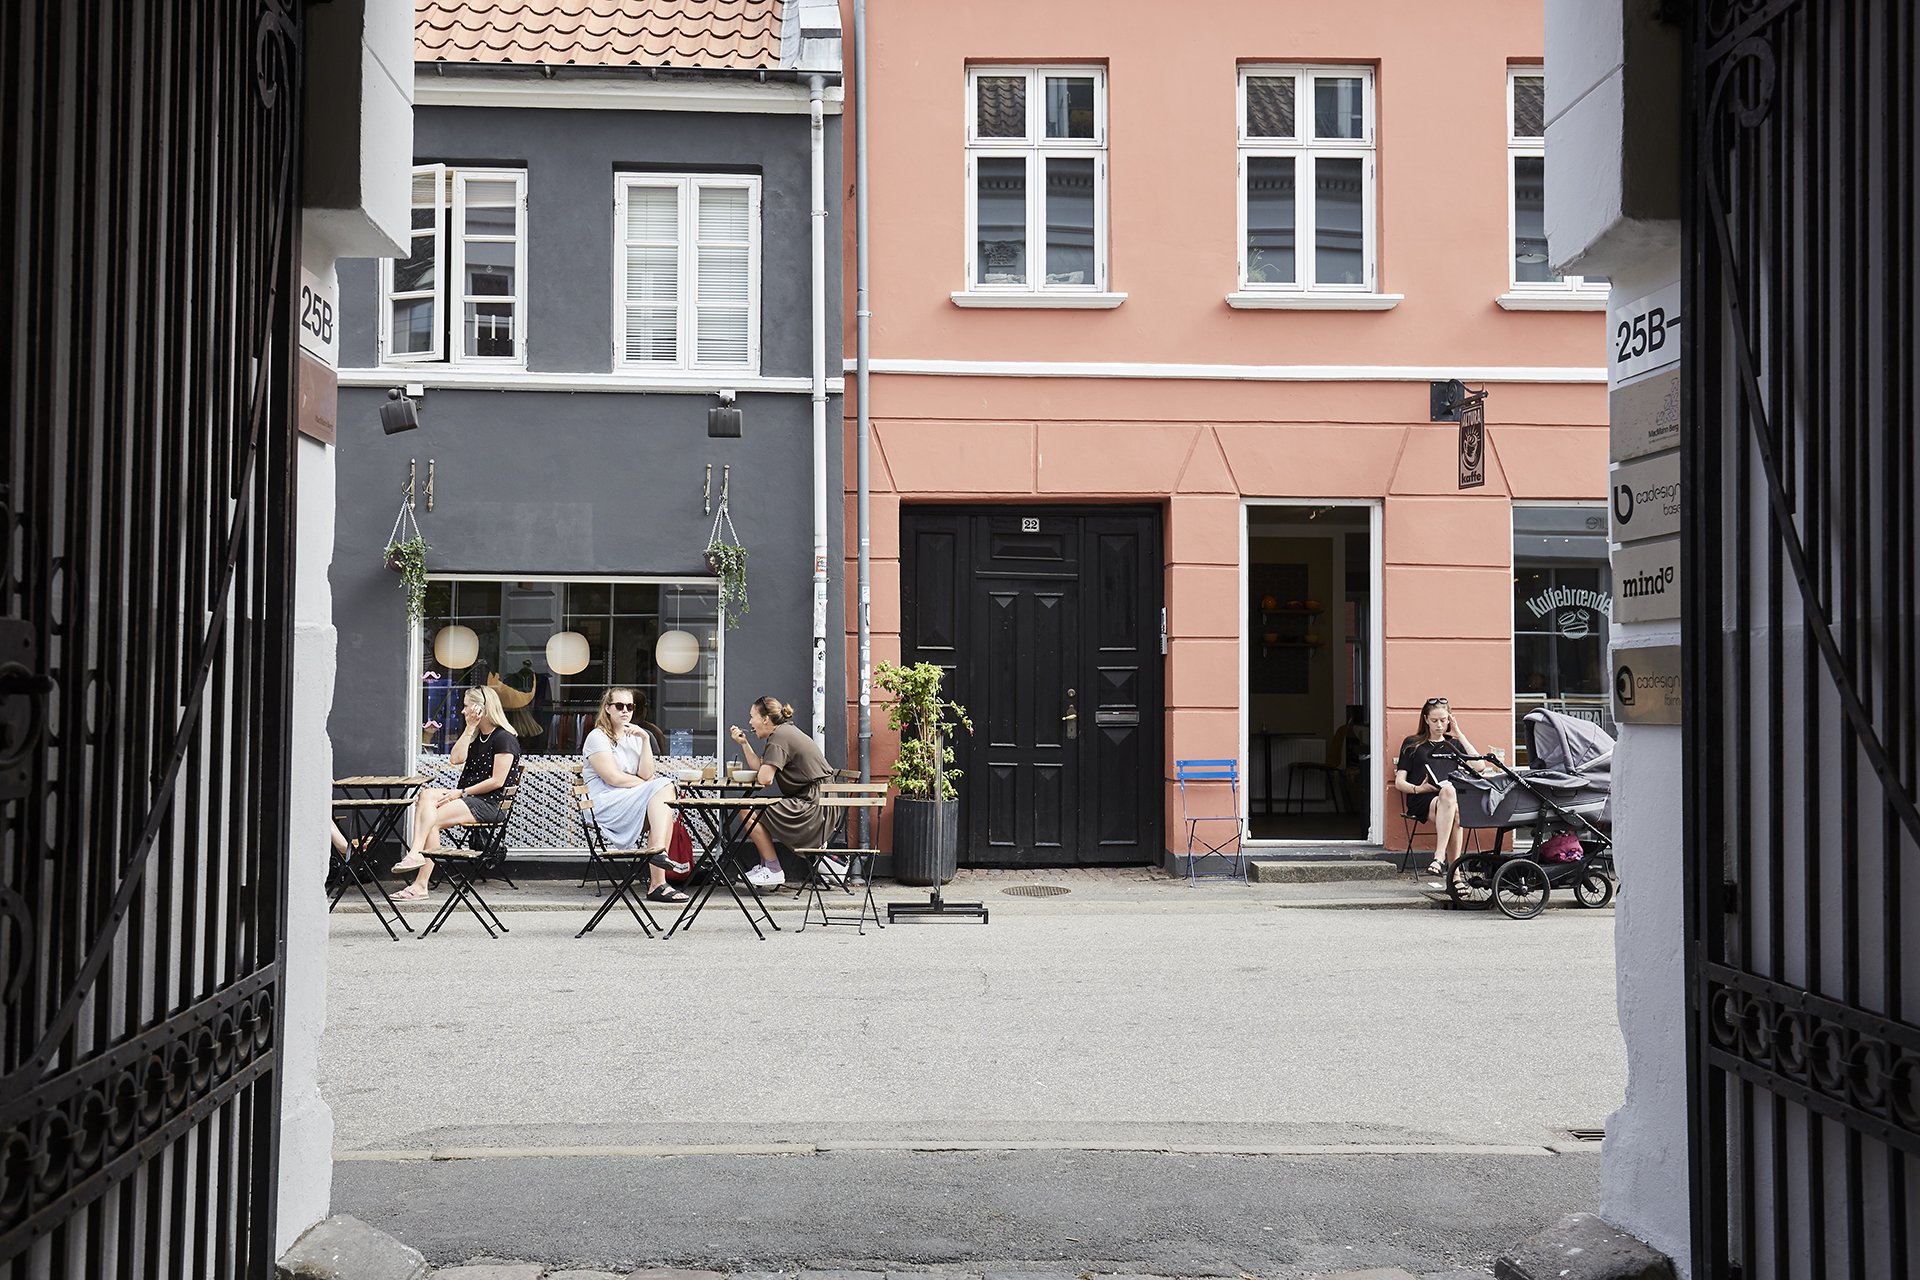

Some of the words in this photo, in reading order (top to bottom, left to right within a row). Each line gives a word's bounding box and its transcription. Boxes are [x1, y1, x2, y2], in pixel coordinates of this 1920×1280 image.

[302, 285, 331, 344] 25B
[1461, 470, 1481, 484] kaffe
[1636, 483, 1681, 504] cadesign
[1024, 519, 1037, 529] 22
[1525, 584, 1612, 619] Kaffebrænde
[1637, 671, 1680, 694] cadesign
